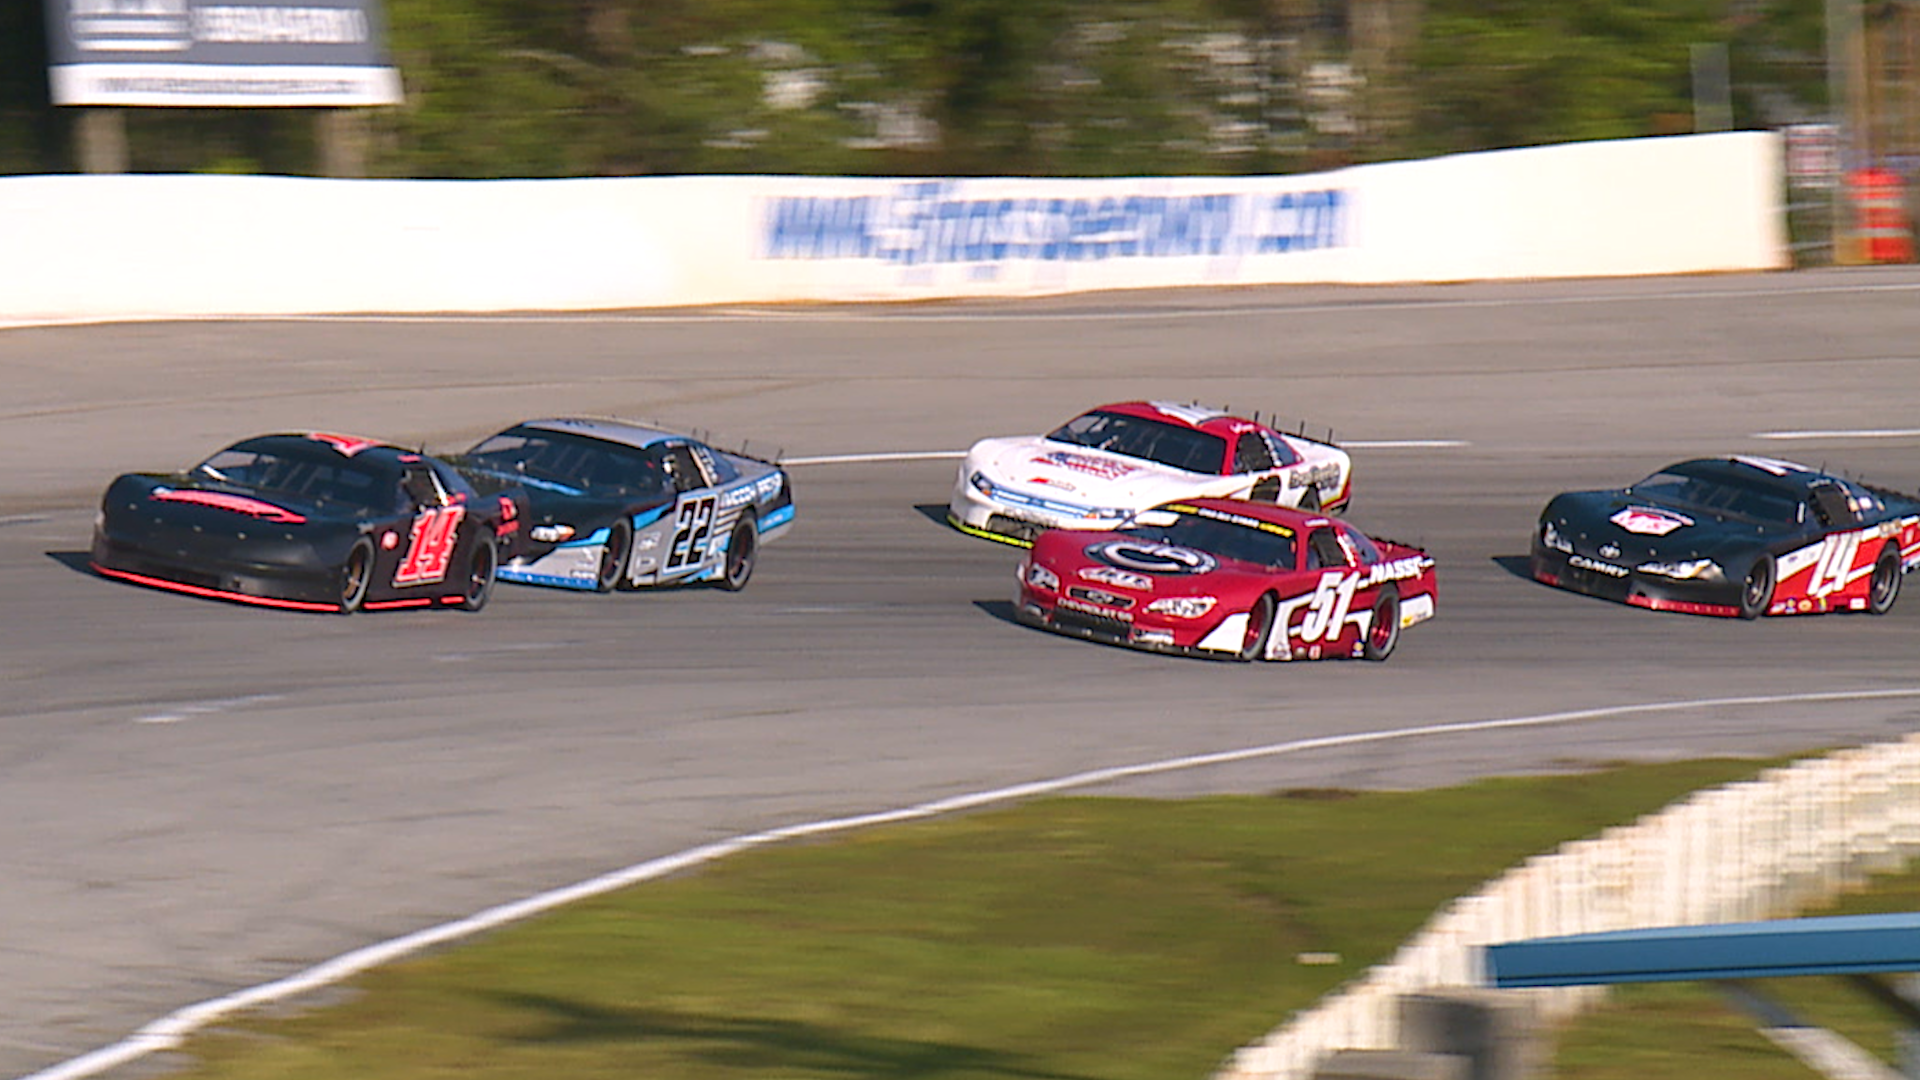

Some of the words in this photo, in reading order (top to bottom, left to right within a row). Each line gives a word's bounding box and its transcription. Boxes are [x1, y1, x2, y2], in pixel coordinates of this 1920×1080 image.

[394, 506, 464, 587] 14
[665, 495, 717, 570] 22
[1568, 555, 1630, 579] CAMRY
[1808, 530, 1862, 597] 14
[1300, 571, 1362, 643] 51
